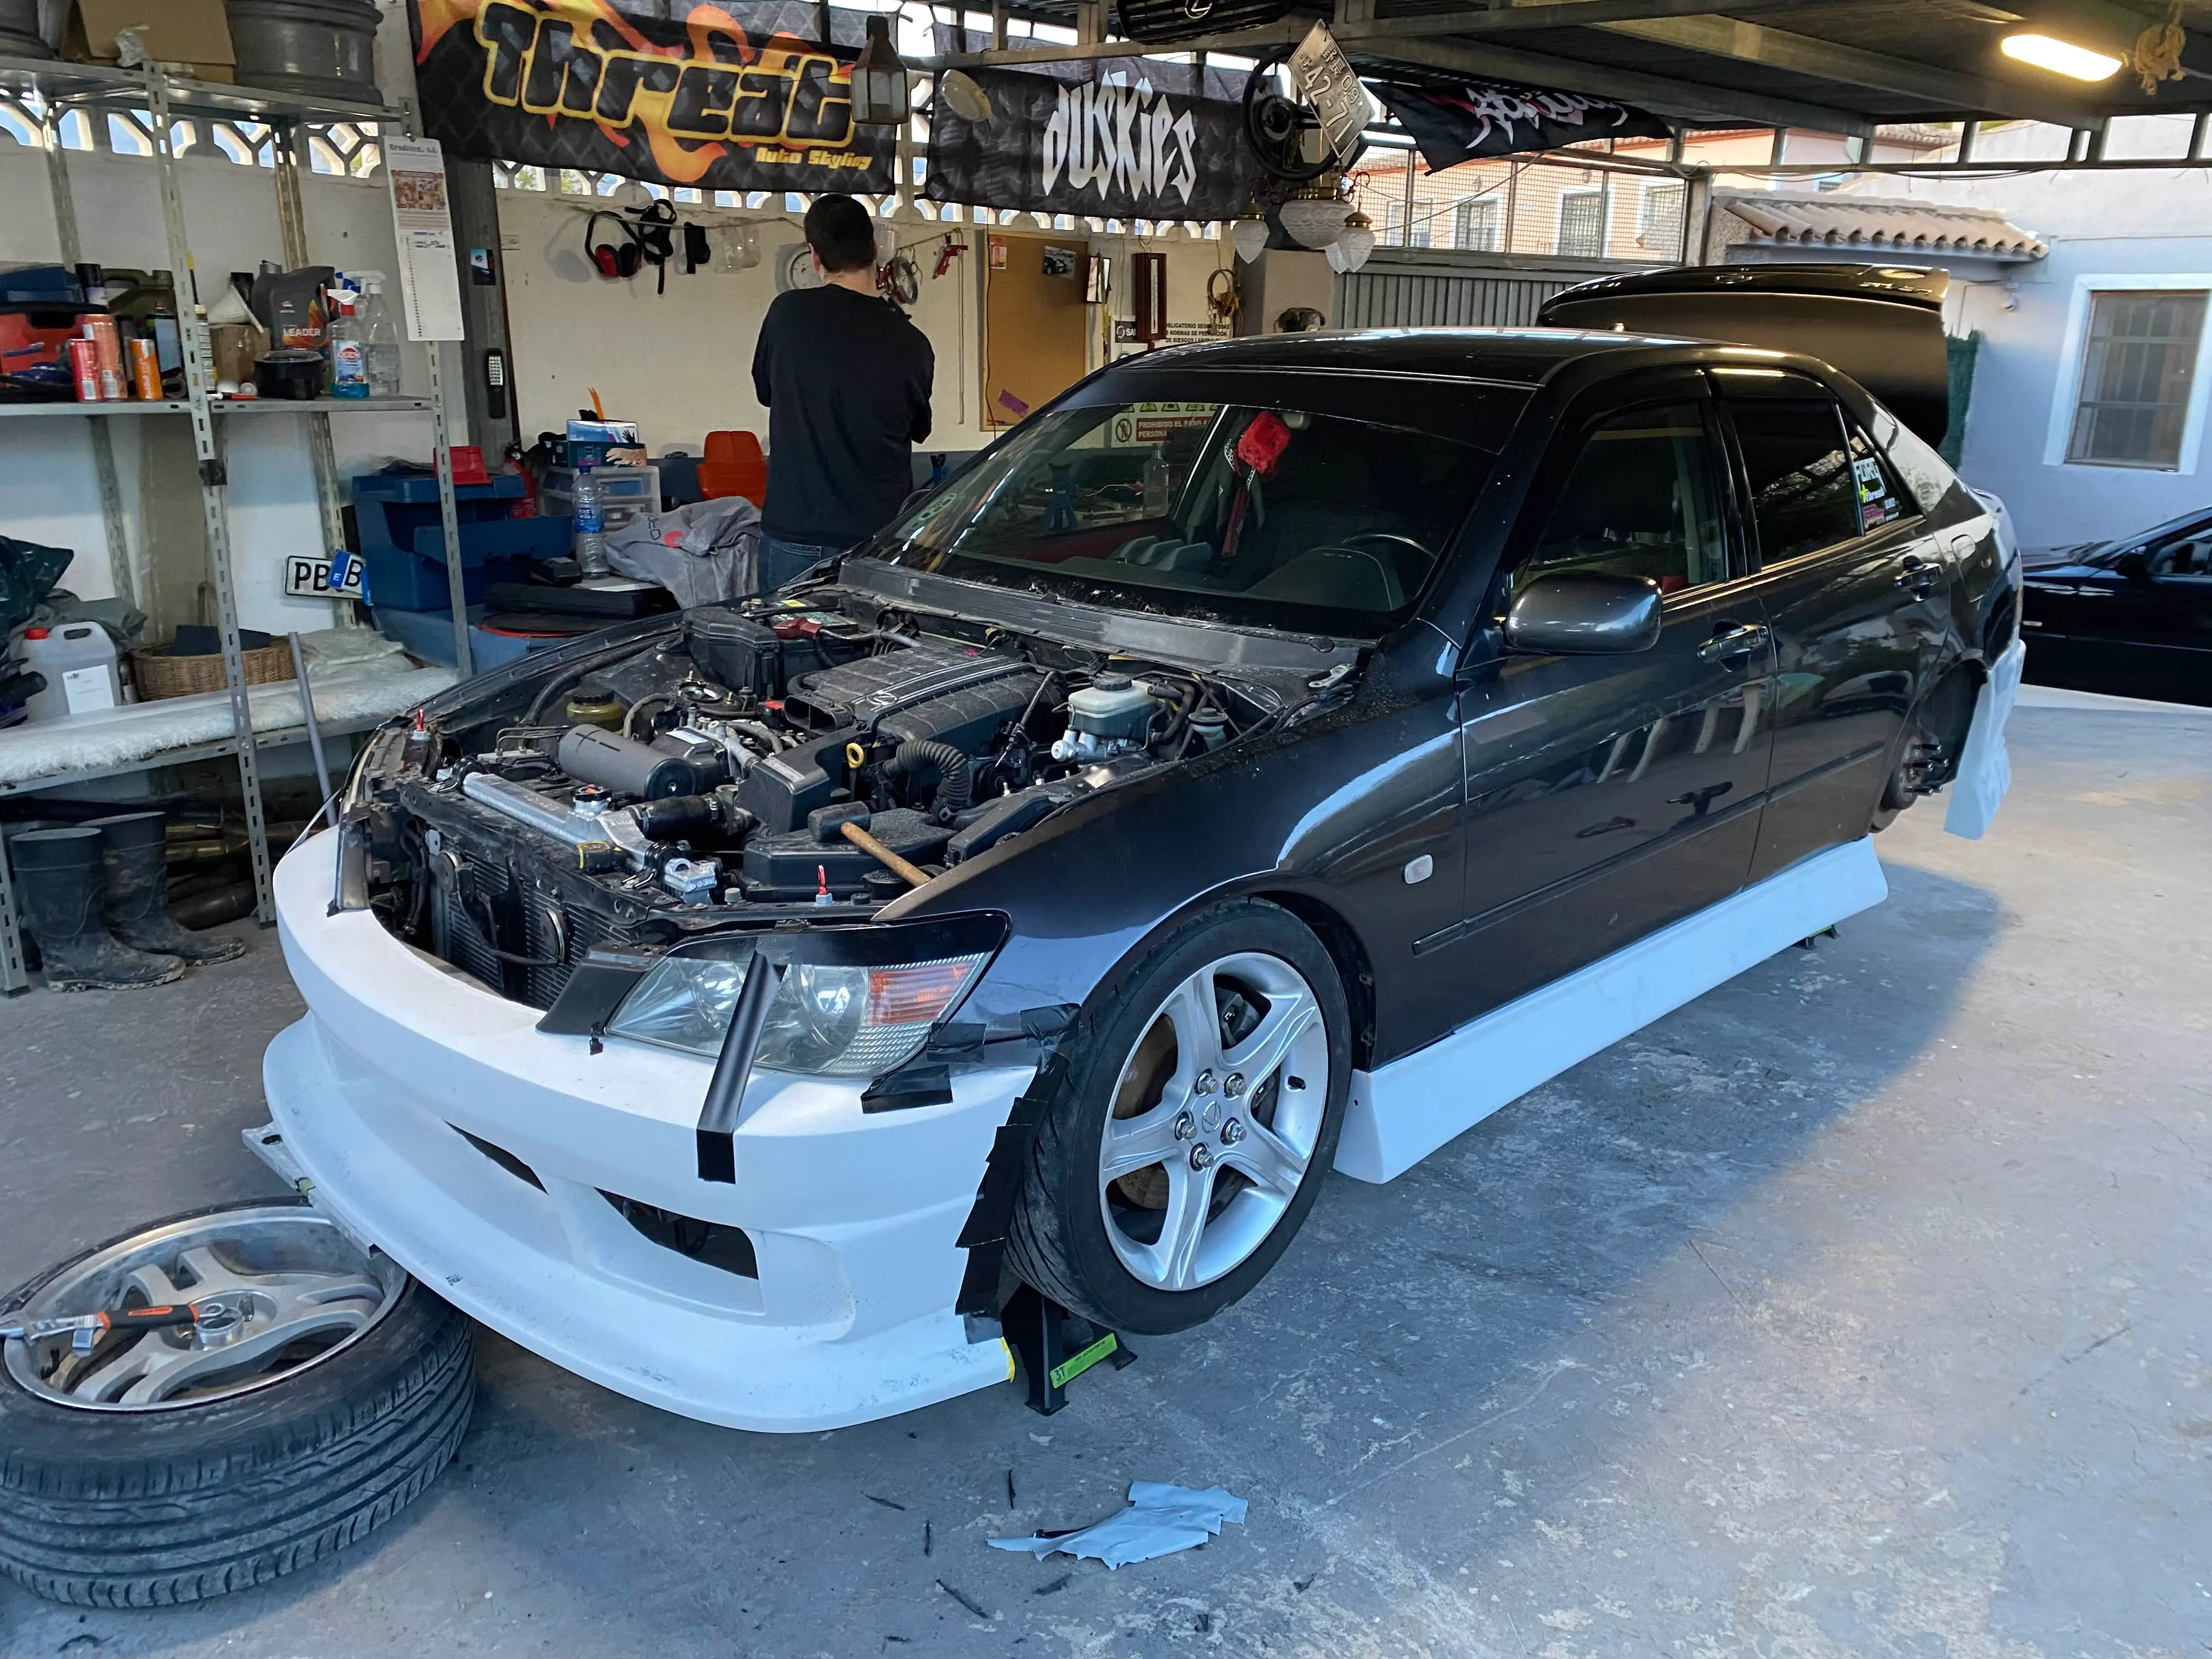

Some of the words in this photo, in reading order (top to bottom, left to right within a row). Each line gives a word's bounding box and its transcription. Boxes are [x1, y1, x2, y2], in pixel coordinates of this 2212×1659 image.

[473, 0, 855, 148] Threat
[755, 146, 803, 164] Auto
[808, 149, 873, 171] Styling
[282, 327, 321, 337] LEADER
